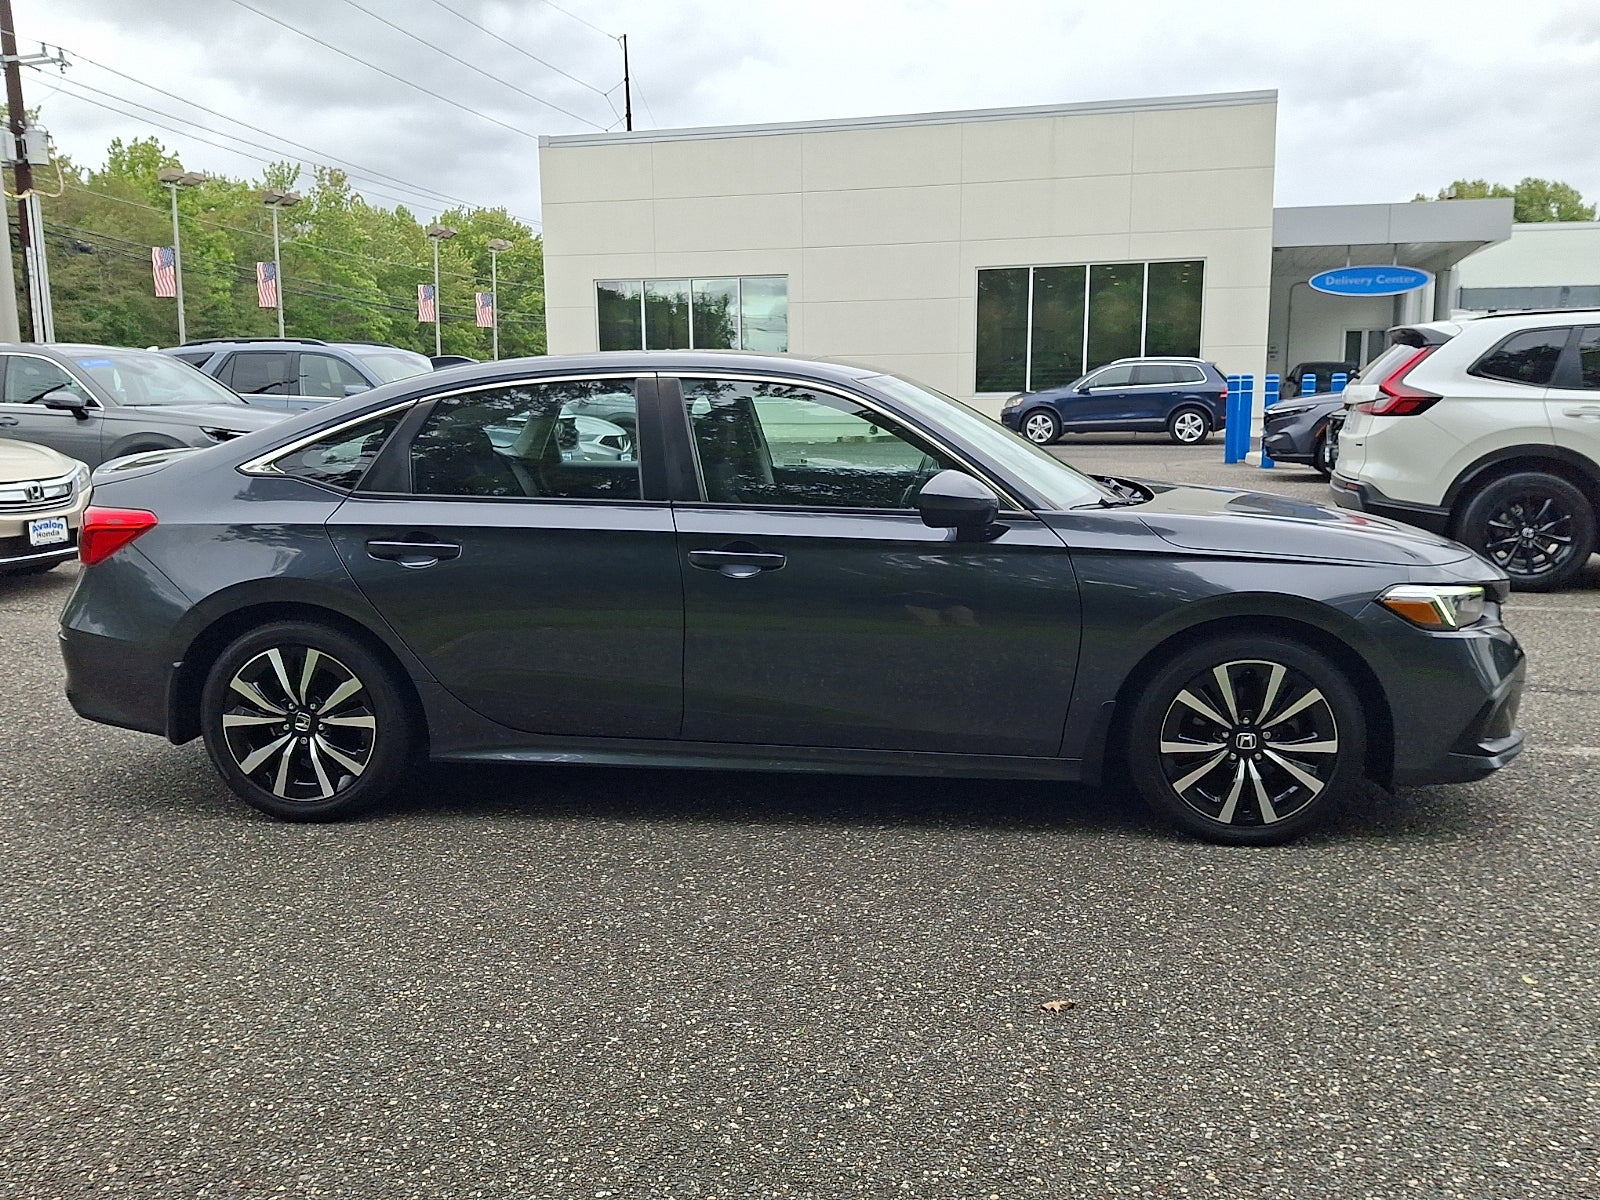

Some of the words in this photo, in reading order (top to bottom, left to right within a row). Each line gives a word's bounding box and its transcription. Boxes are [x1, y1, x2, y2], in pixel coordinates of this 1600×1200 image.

[1325, 275, 1372, 286] Delivery
[1376, 274, 1416, 284] Center
[32, 520, 64, 533] Avalon
[36, 529, 60, 538] Honda
